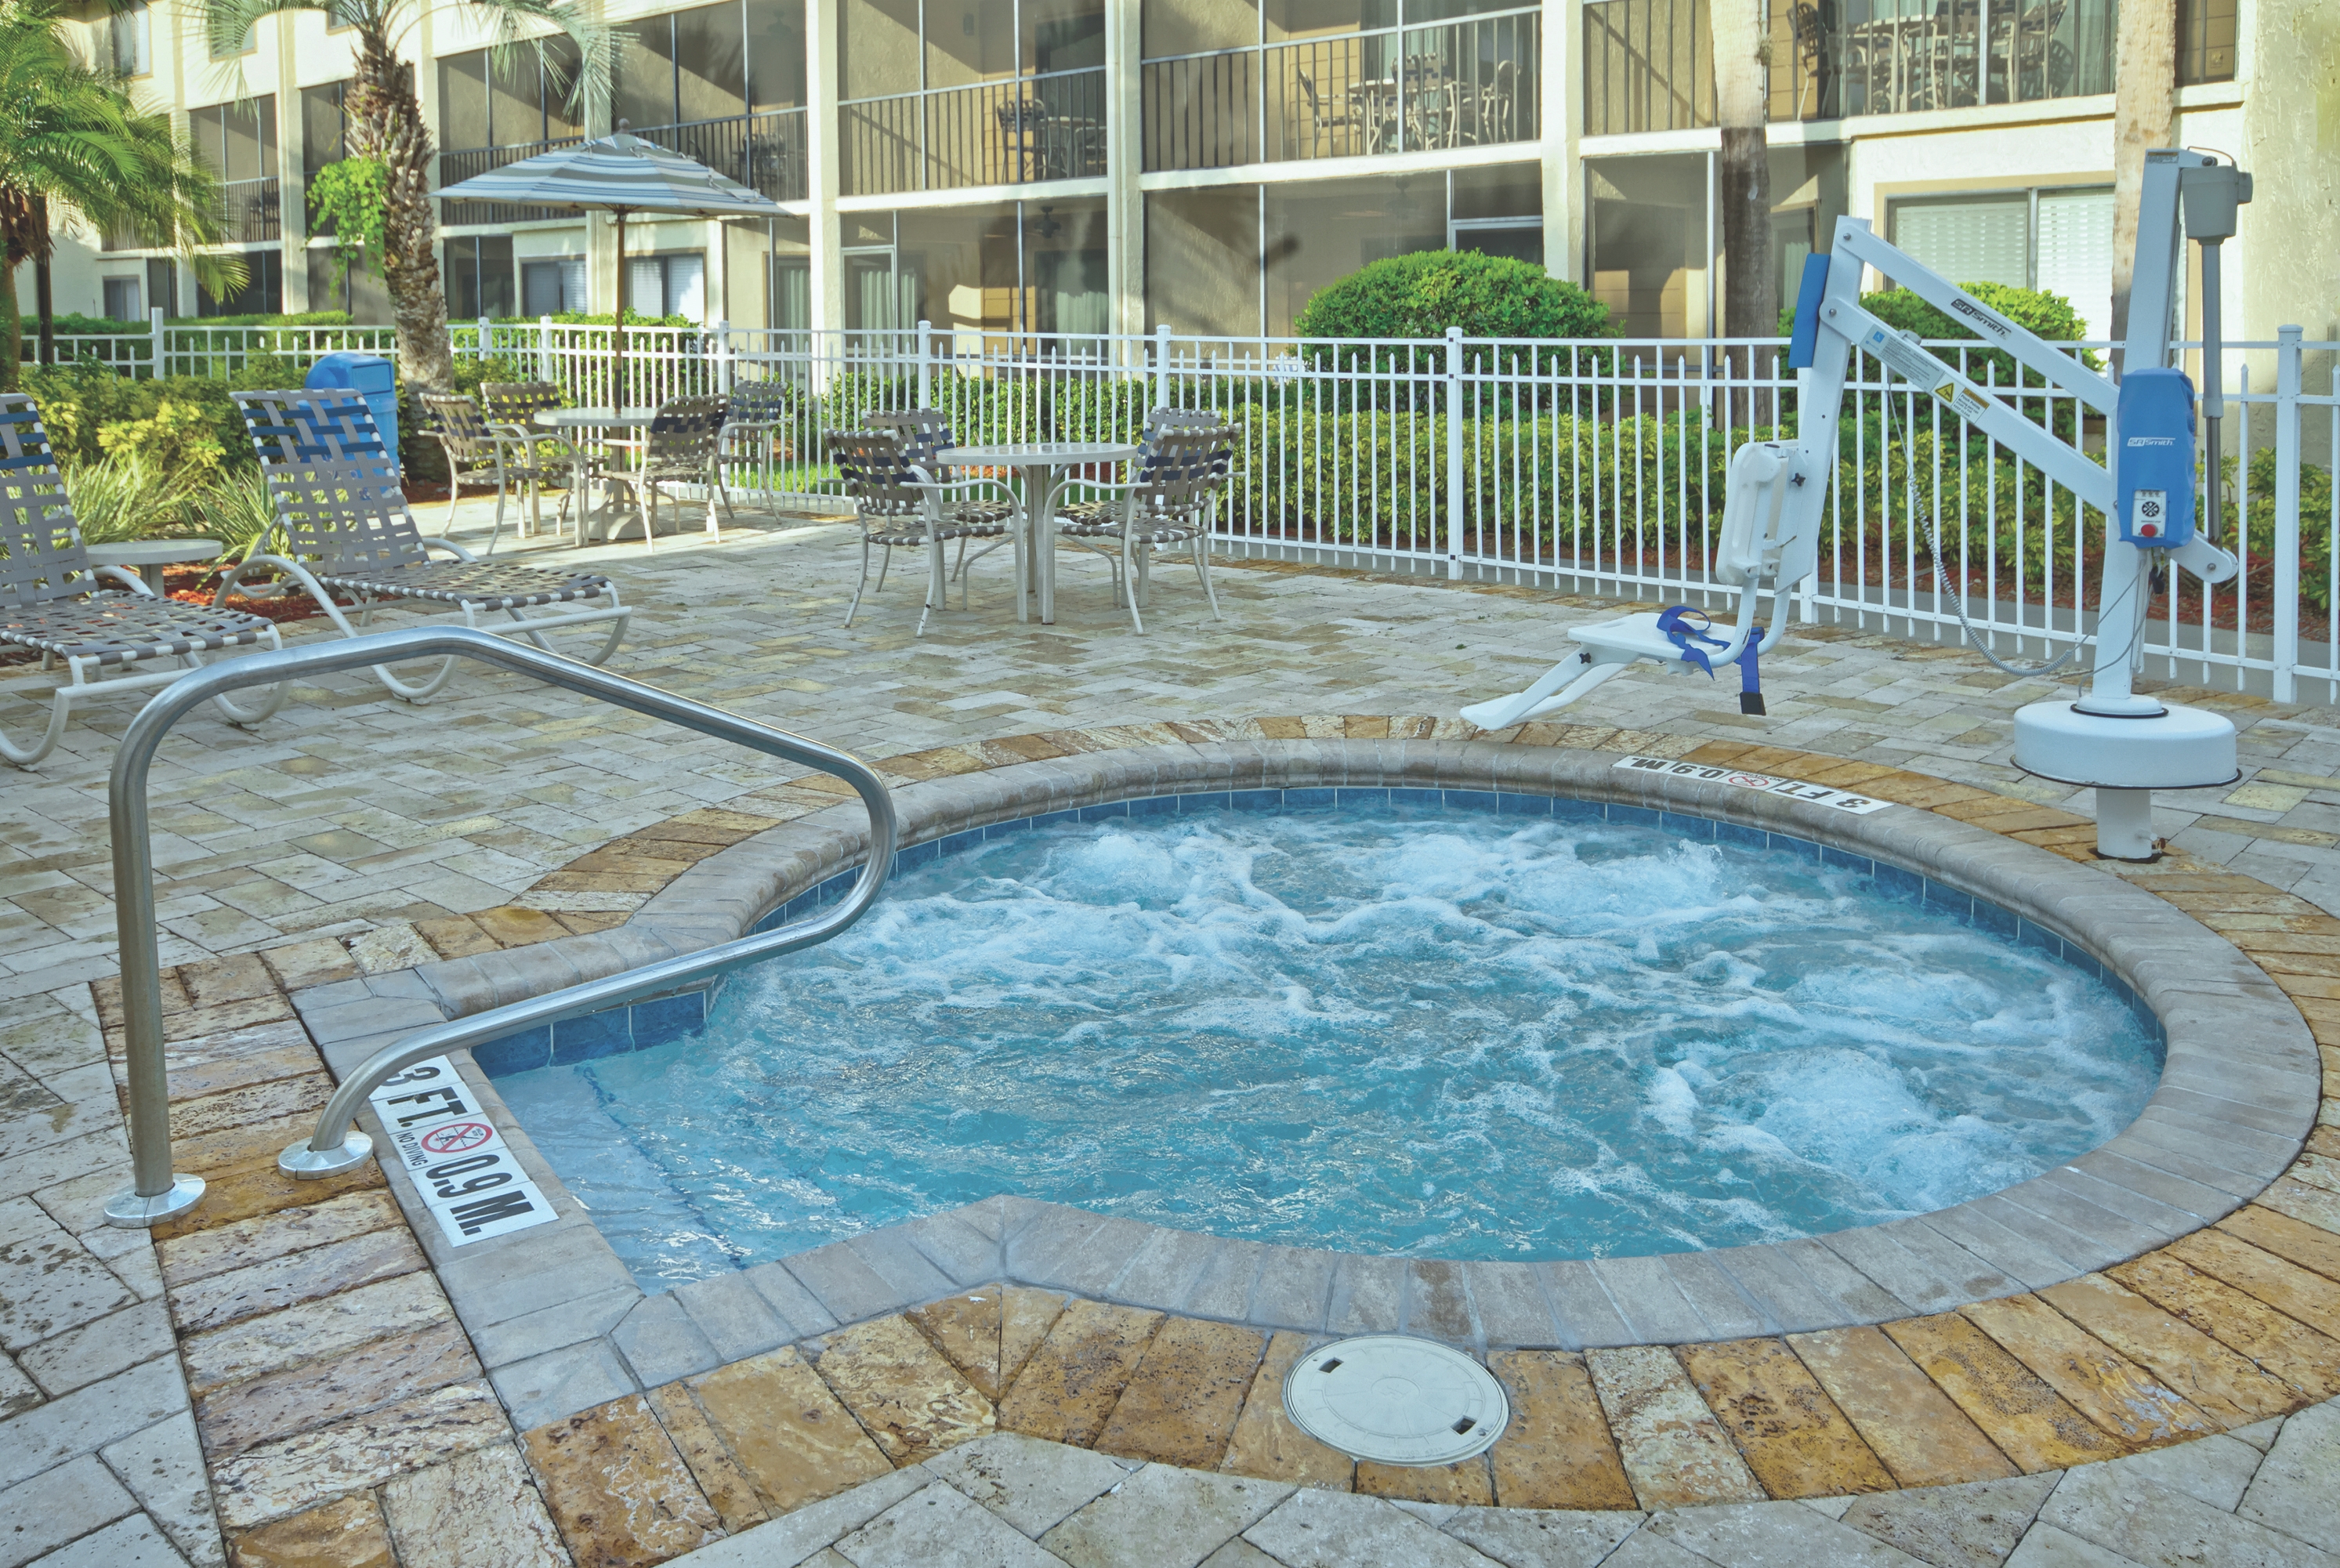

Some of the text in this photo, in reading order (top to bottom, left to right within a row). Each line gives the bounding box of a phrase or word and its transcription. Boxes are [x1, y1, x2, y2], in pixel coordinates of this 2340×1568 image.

[1672, 765, 1724, 779] 0.9
[1835, 798, 1871, 809] 3
[381, 1066, 468, 1128] 3 FT.
[396, 1132, 428, 1166] NO DIVING
[426, 1154, 535, 1237] 0.9 M.
